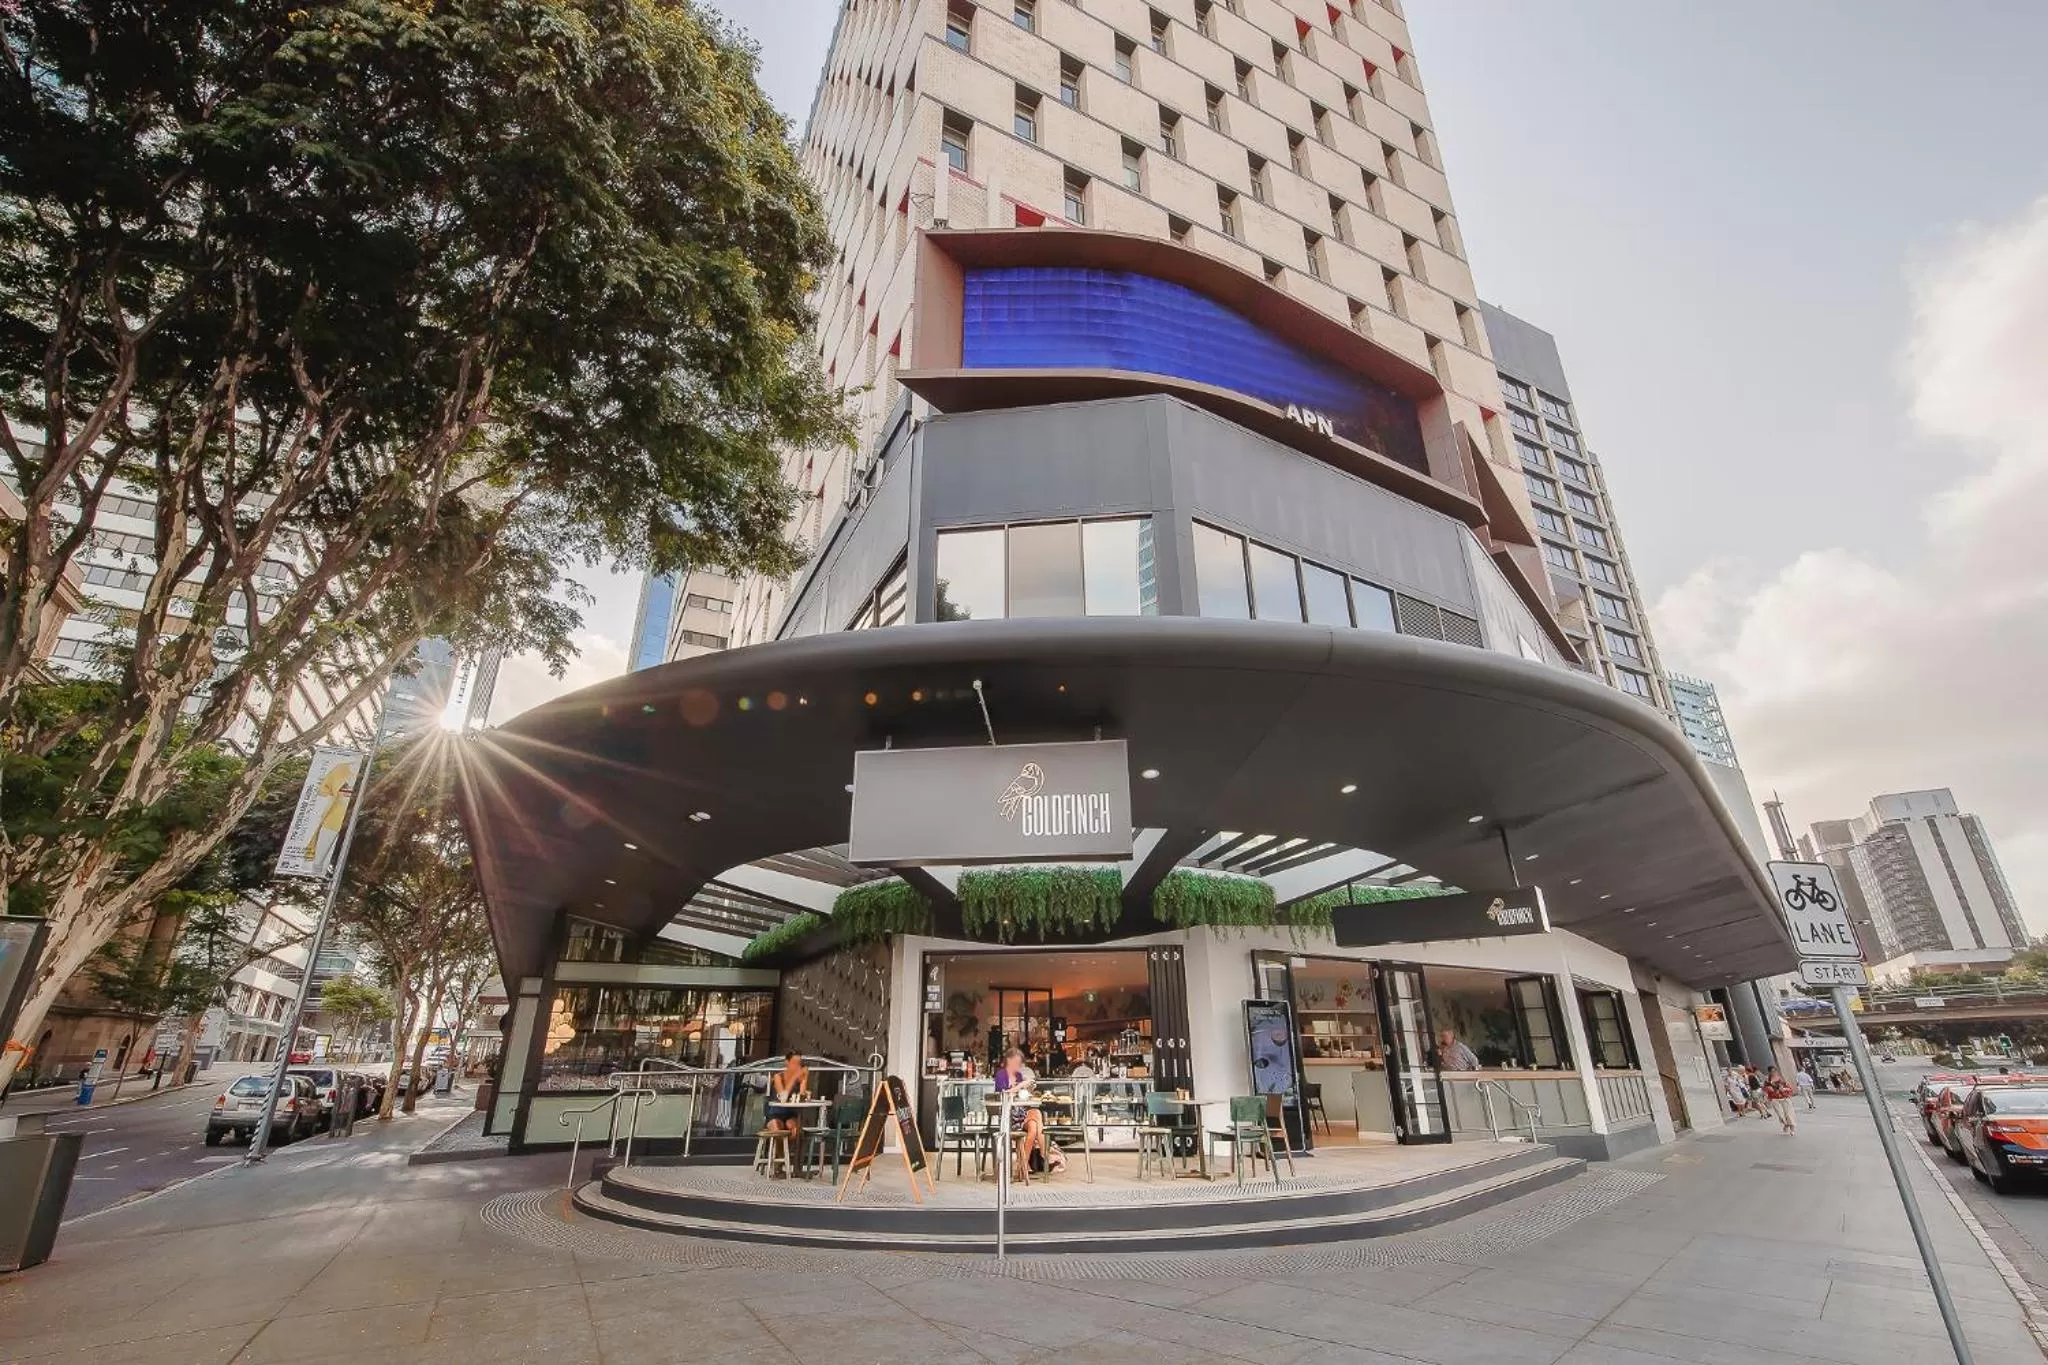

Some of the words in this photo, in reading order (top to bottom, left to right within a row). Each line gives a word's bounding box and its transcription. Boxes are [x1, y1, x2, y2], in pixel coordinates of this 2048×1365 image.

[1286, 402, 1334, 438] APN
[1021, 792, 1111, 837] GOLDFINCH
[1794, 921, 1852, 945] LANE
[1814, 966, 1857, 980] START
